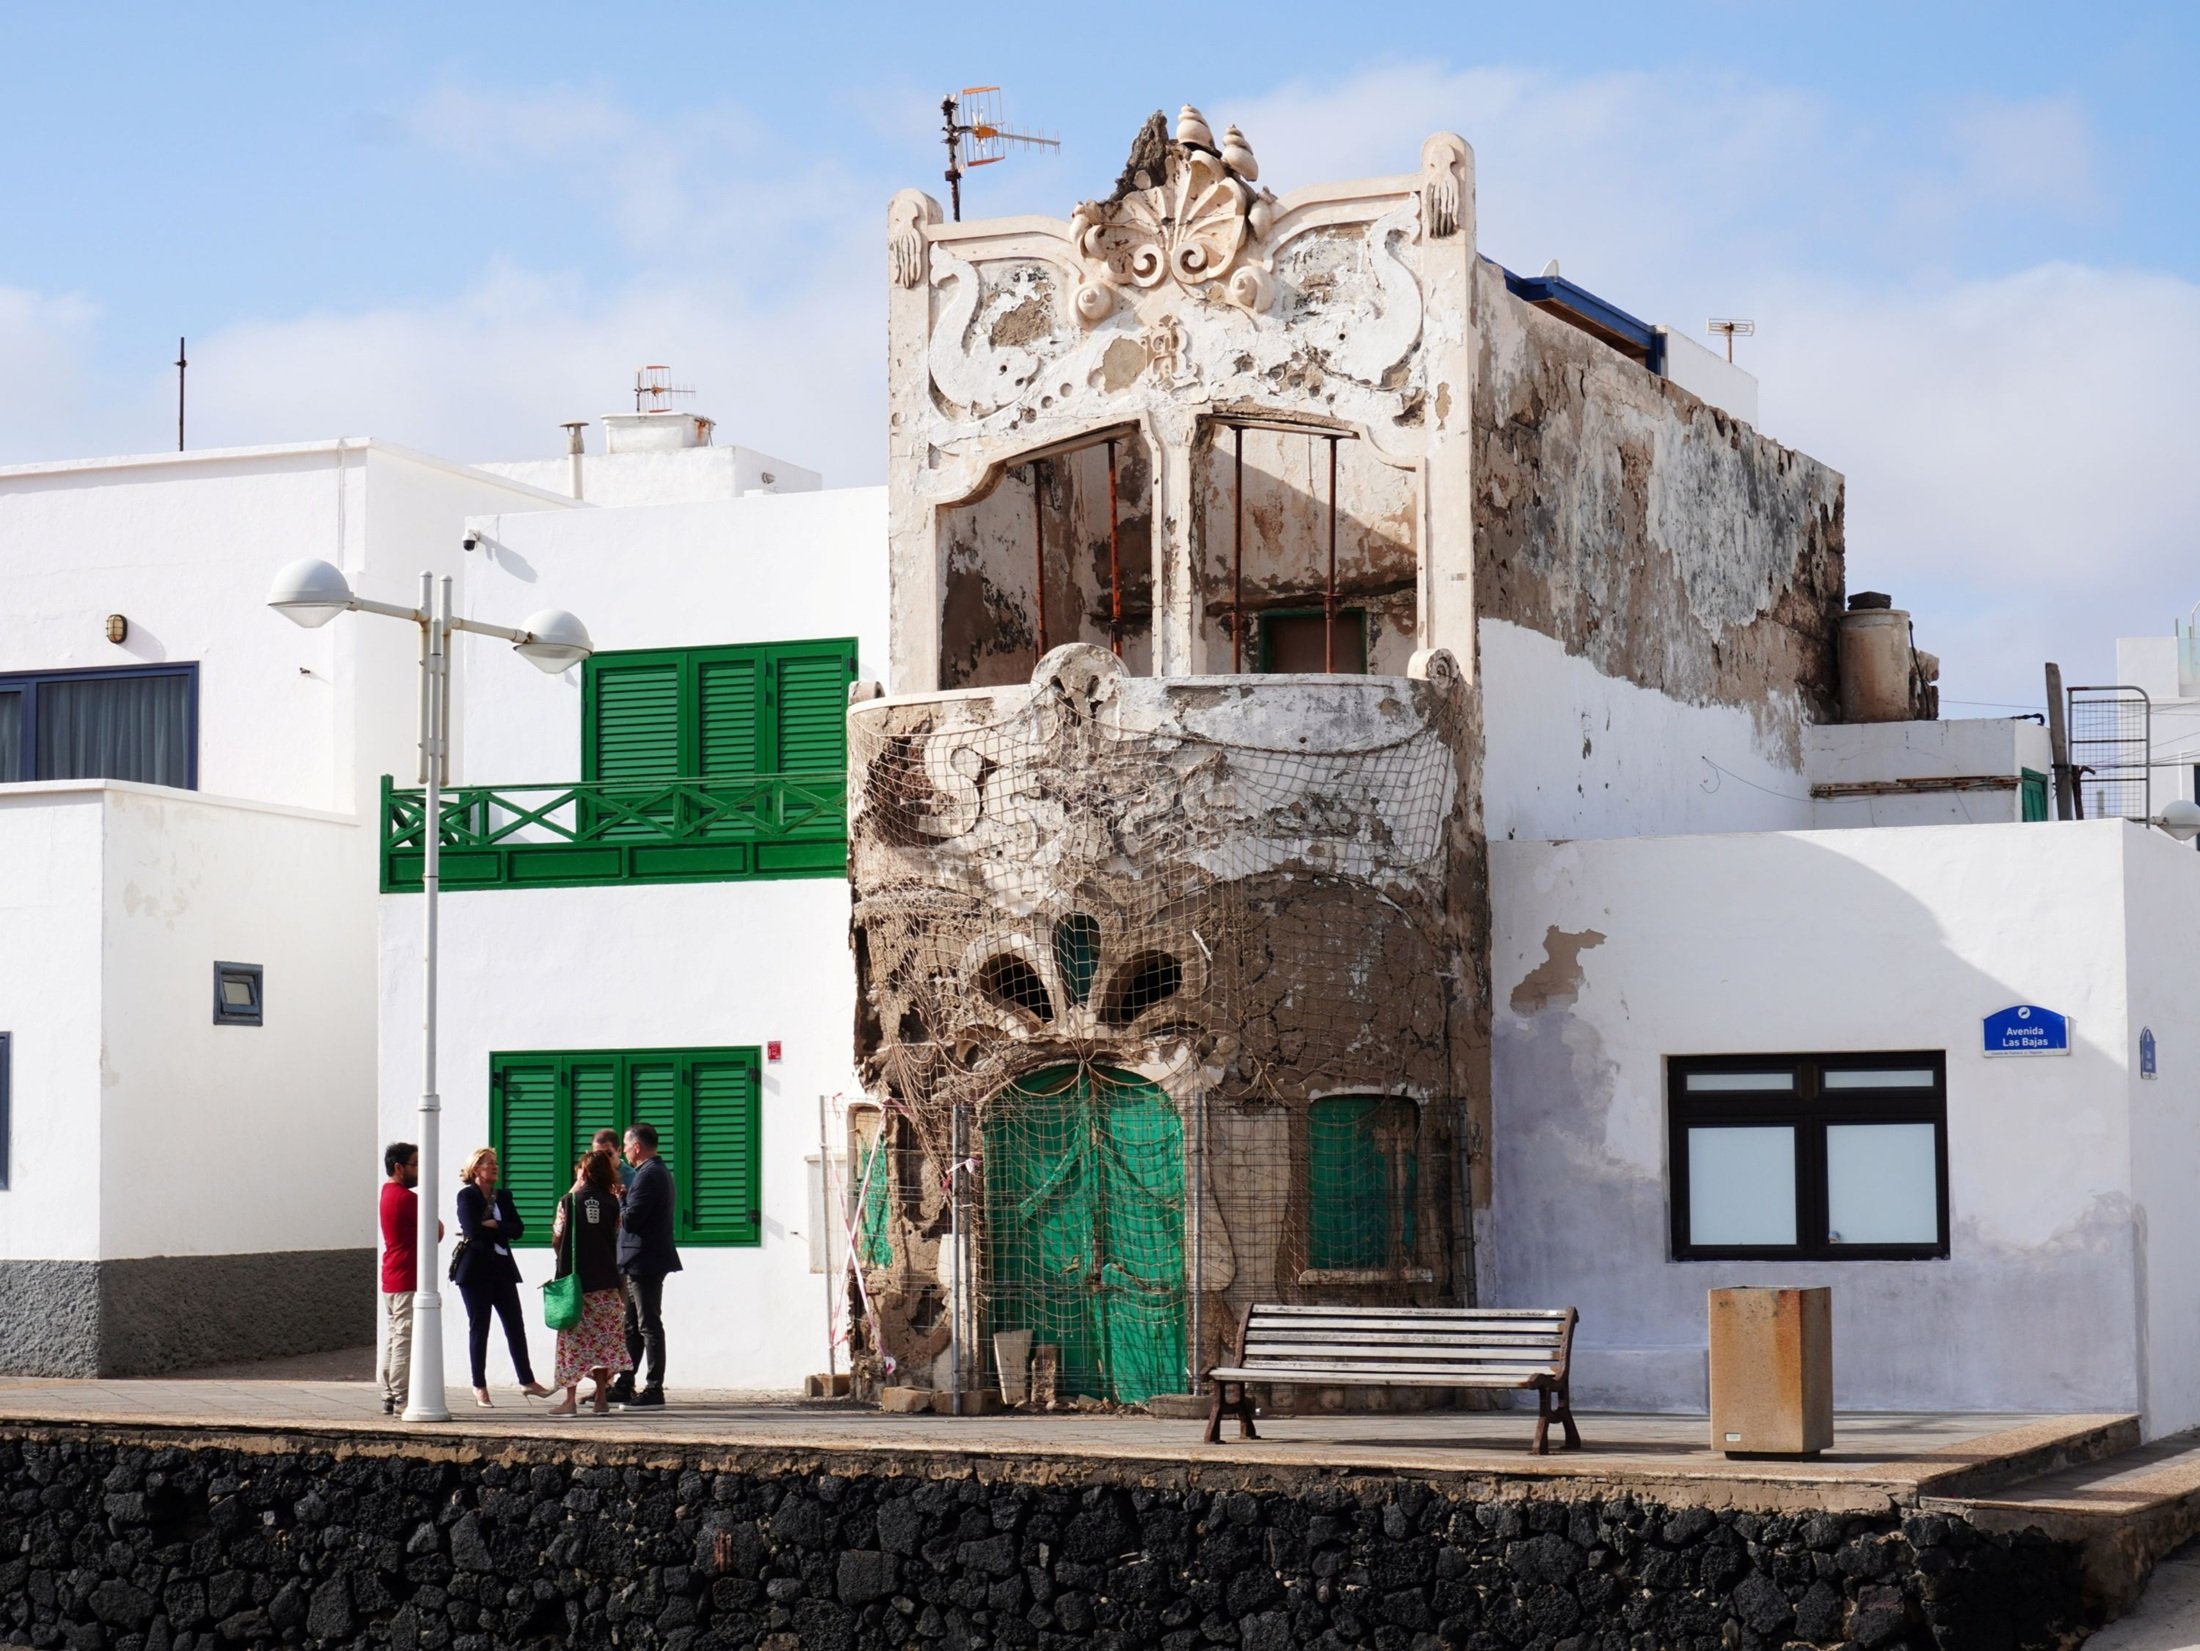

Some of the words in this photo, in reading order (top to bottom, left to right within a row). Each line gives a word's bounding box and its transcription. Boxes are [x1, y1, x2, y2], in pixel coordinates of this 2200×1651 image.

[2006, 1026, 2044, 1036] Avenida
[2002, 1038, 2020, 1047] Las
[2022, 1037, 2049, 1048] Bajas
